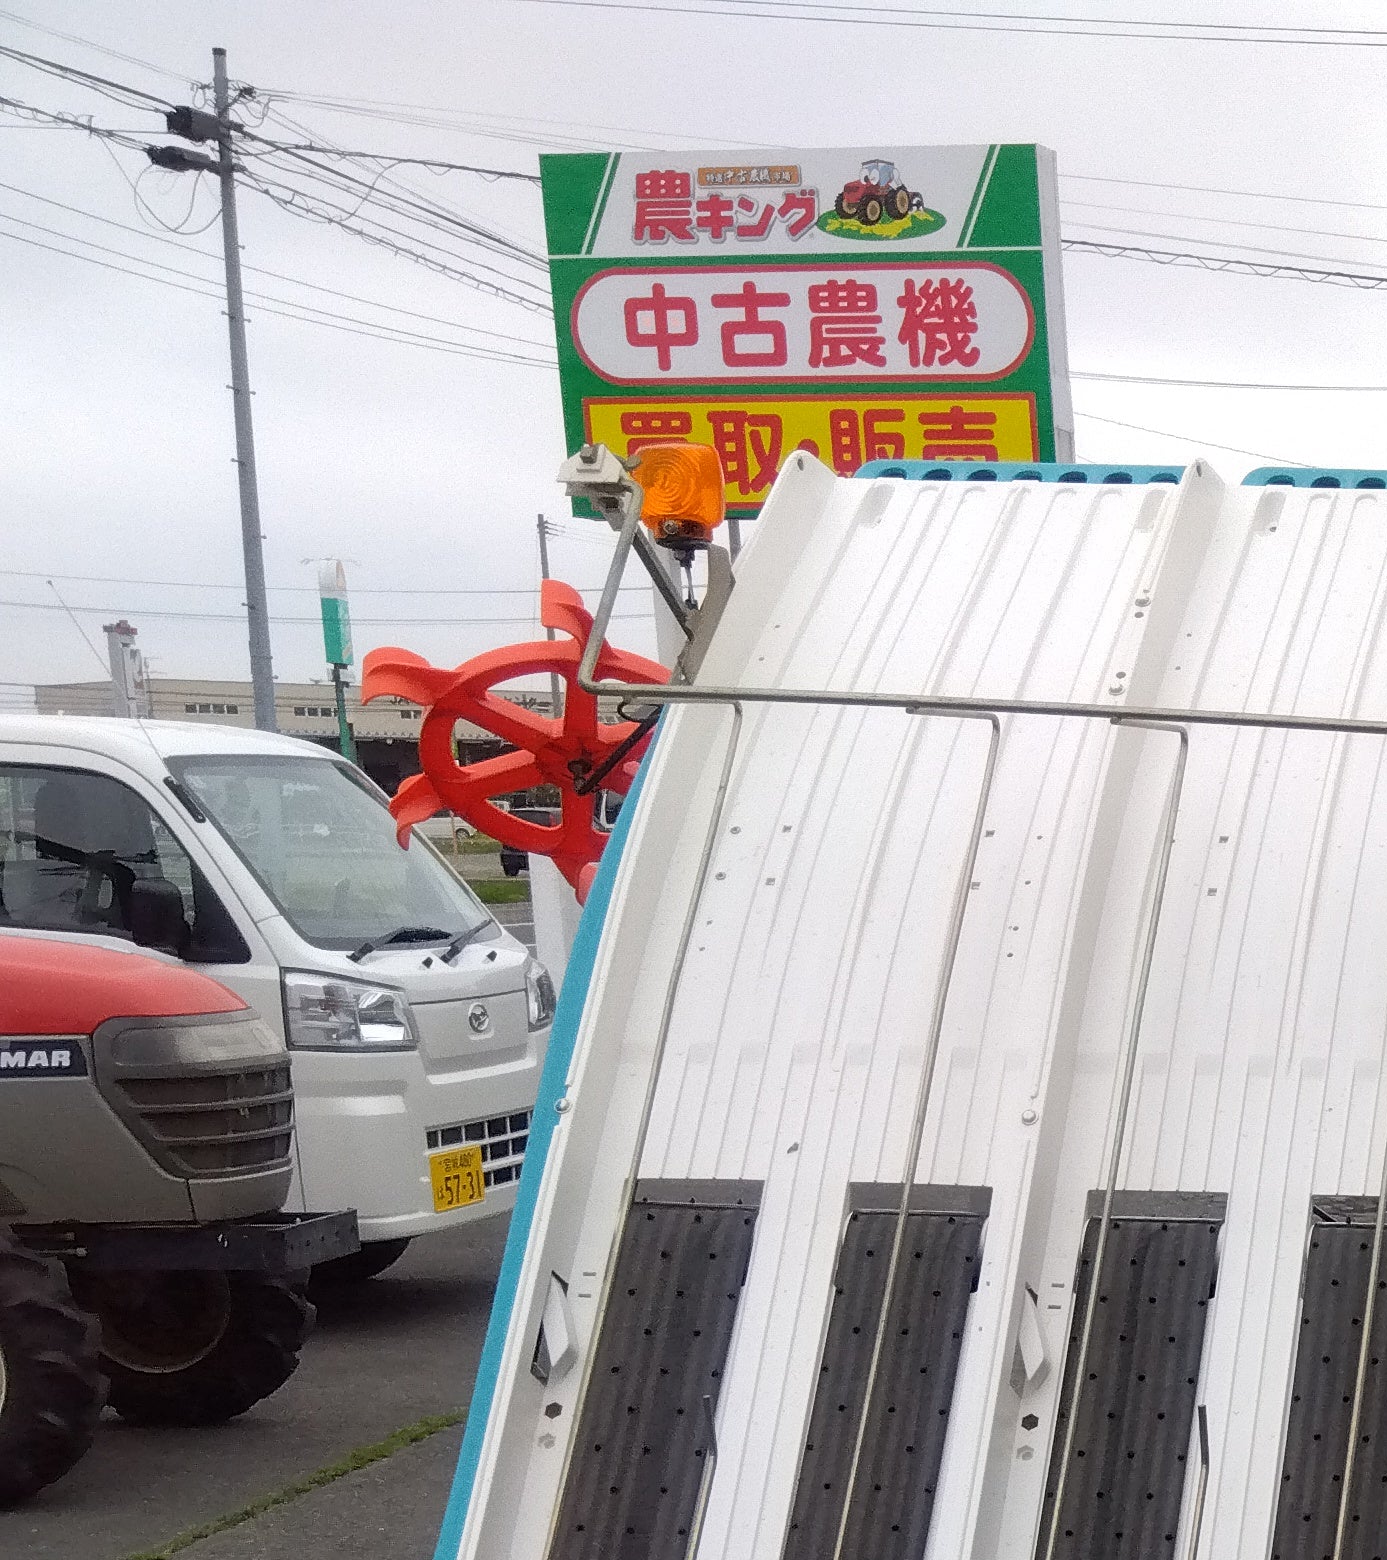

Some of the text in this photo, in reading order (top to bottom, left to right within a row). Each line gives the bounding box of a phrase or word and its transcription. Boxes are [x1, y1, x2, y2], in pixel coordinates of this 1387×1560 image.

[634, 170, 816, 240] 農キング
[624, 278, 980, 370] 中古農機
